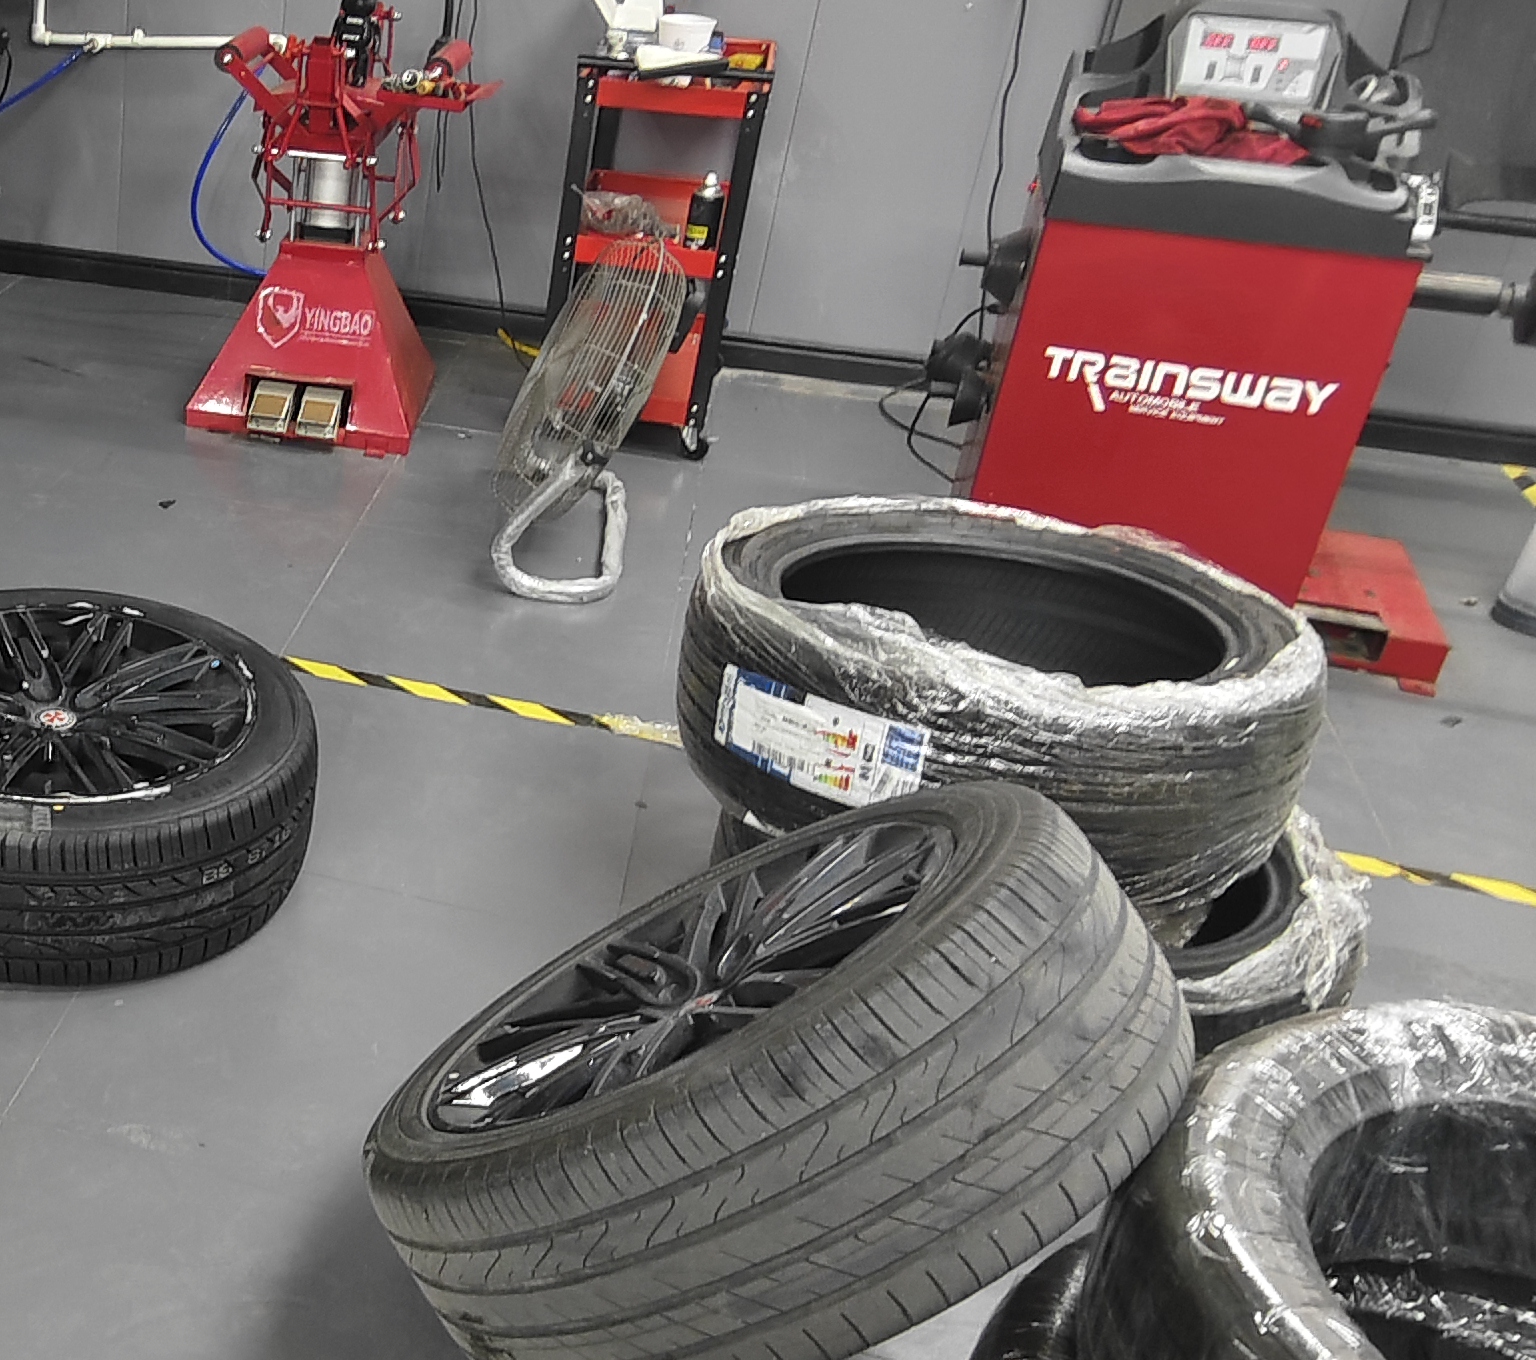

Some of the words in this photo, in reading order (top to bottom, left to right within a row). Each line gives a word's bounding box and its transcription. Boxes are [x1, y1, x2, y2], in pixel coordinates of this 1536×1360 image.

[304, 305, 373, 336] YINGBAO
[1043, 344, 1341, 417] TRAINSWAY
[1108, 389, 1202, 412] AUTOMOBILE
